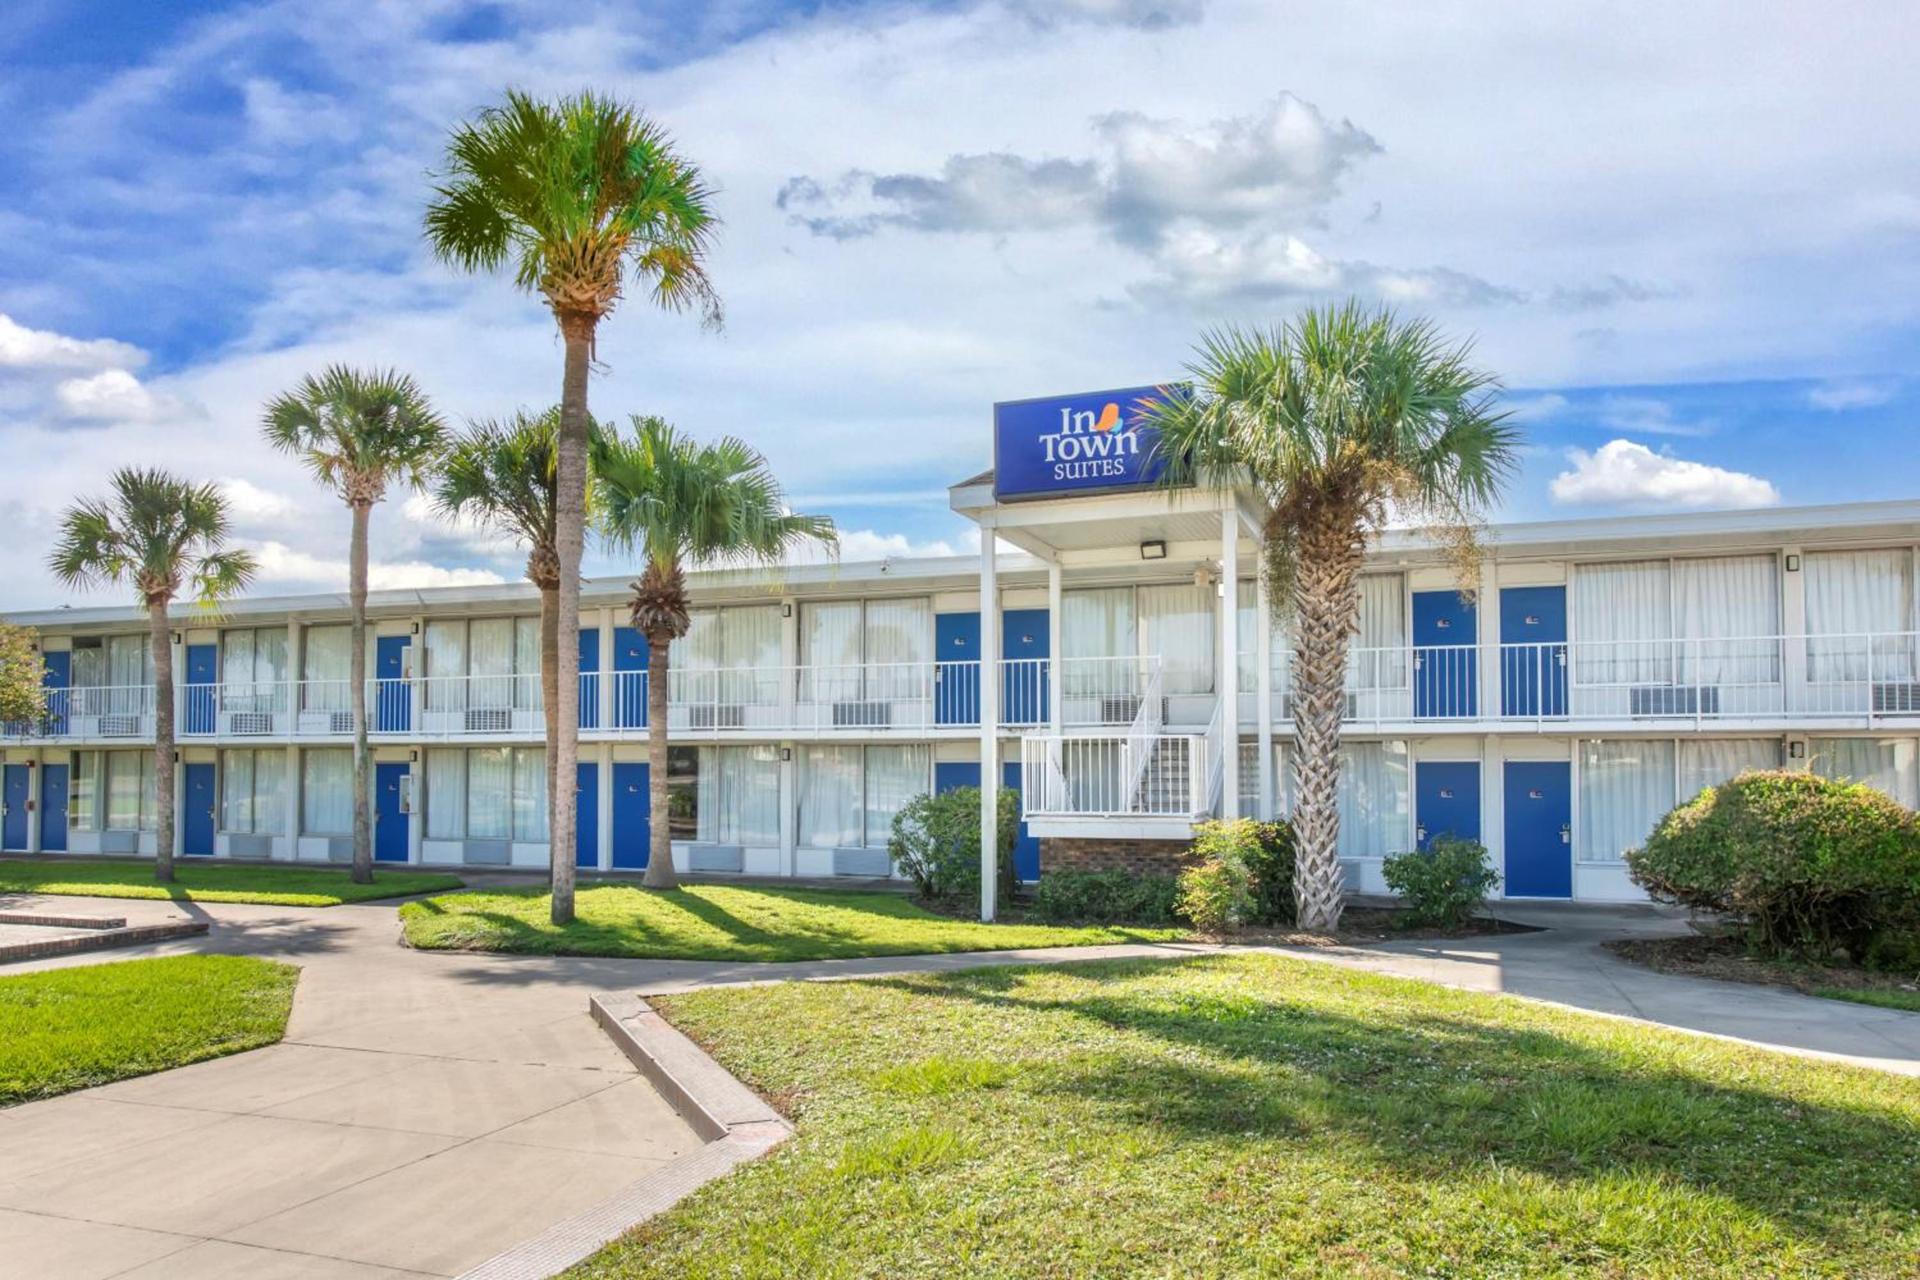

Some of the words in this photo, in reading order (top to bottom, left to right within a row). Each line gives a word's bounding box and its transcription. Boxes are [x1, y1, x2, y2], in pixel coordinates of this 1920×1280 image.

[1061, 408, 1097, 435] In
[1039, 431, 1139, 462] Town
[1055, 458, 1124, 480] SUITES
